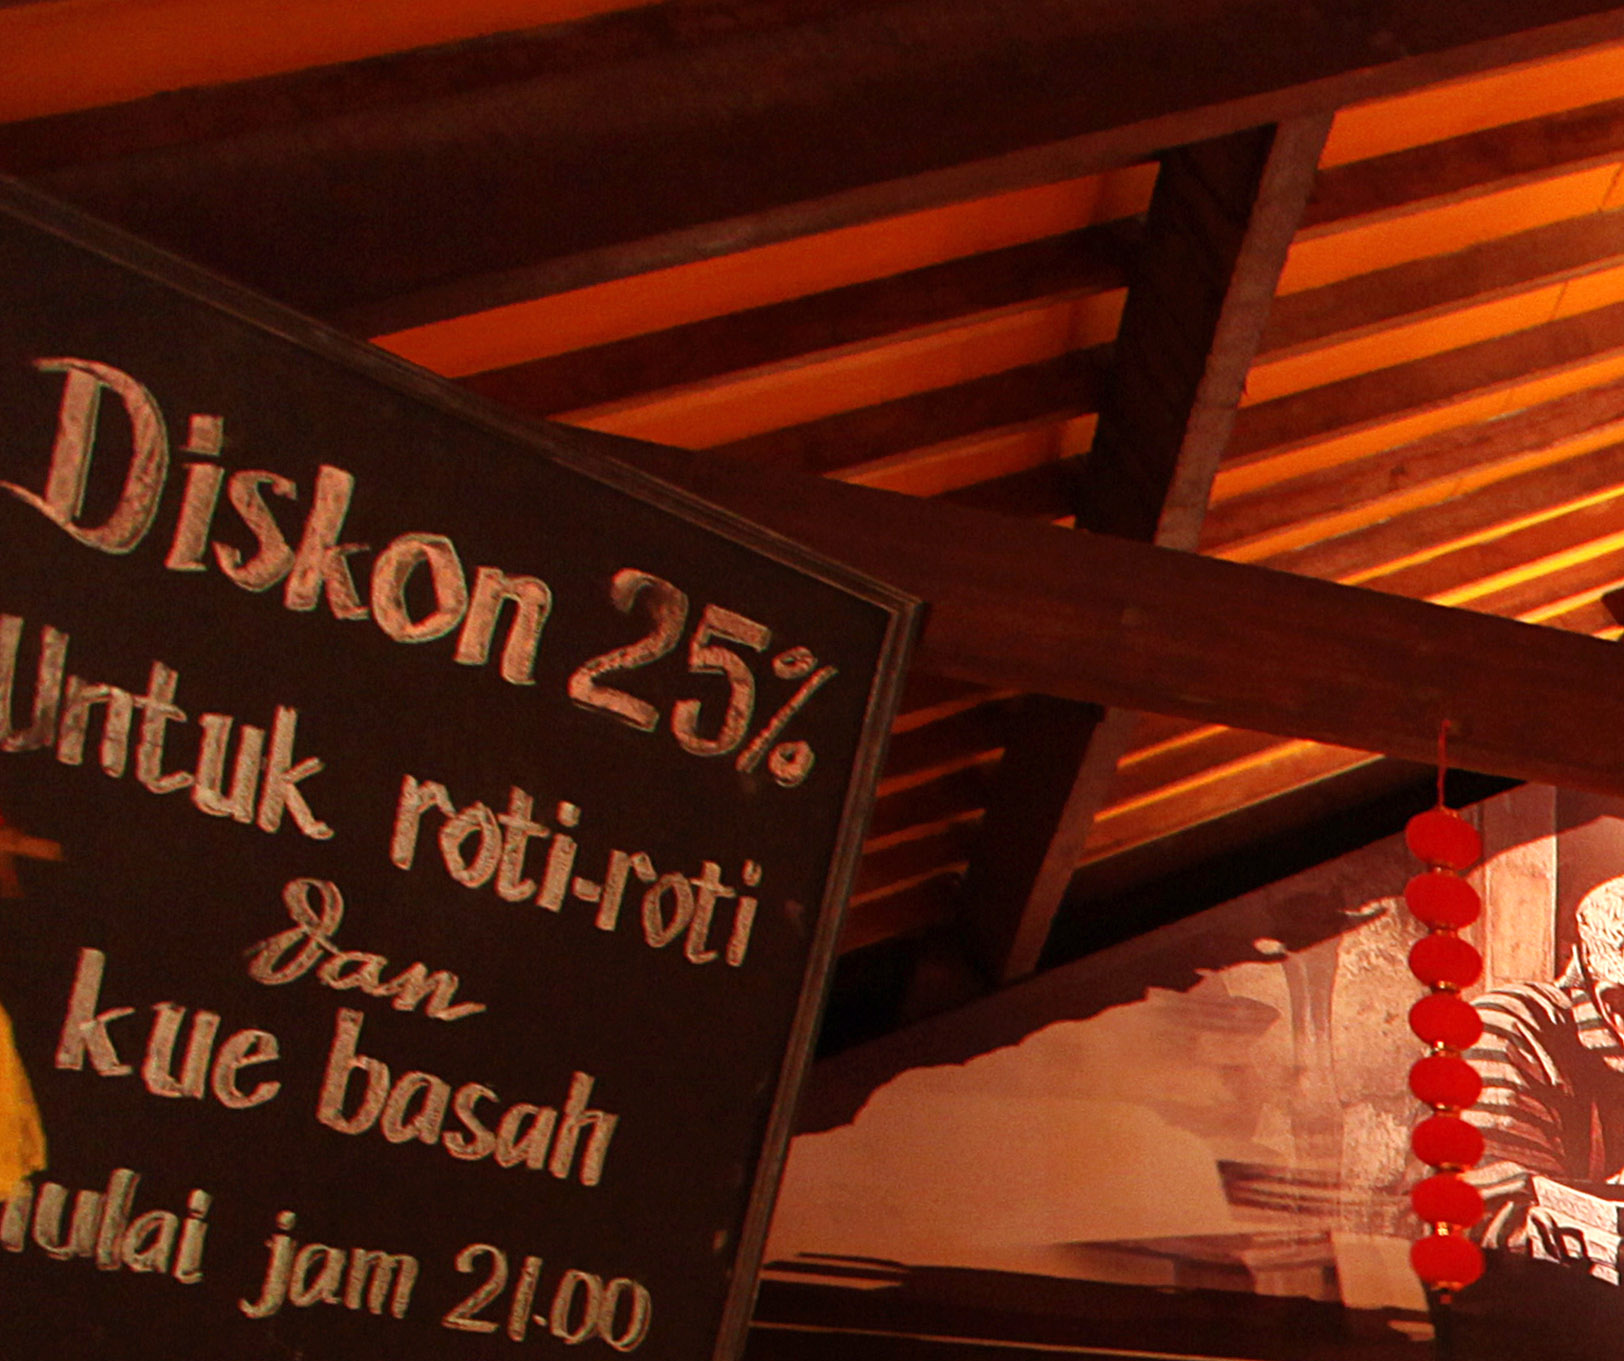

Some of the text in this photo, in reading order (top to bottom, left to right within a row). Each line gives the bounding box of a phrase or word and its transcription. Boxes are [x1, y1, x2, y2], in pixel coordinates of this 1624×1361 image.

[0, 356, 841, 789] Diskon 25%
[0, 614, 762, 967] Untuk roti-roti
[55, 948, 620, 1187] kue basah
[245, 878, 487, 1021] dan
[240, 1210, 420, 1321] jam
[443, 1244, 652, 1352] 21.00
